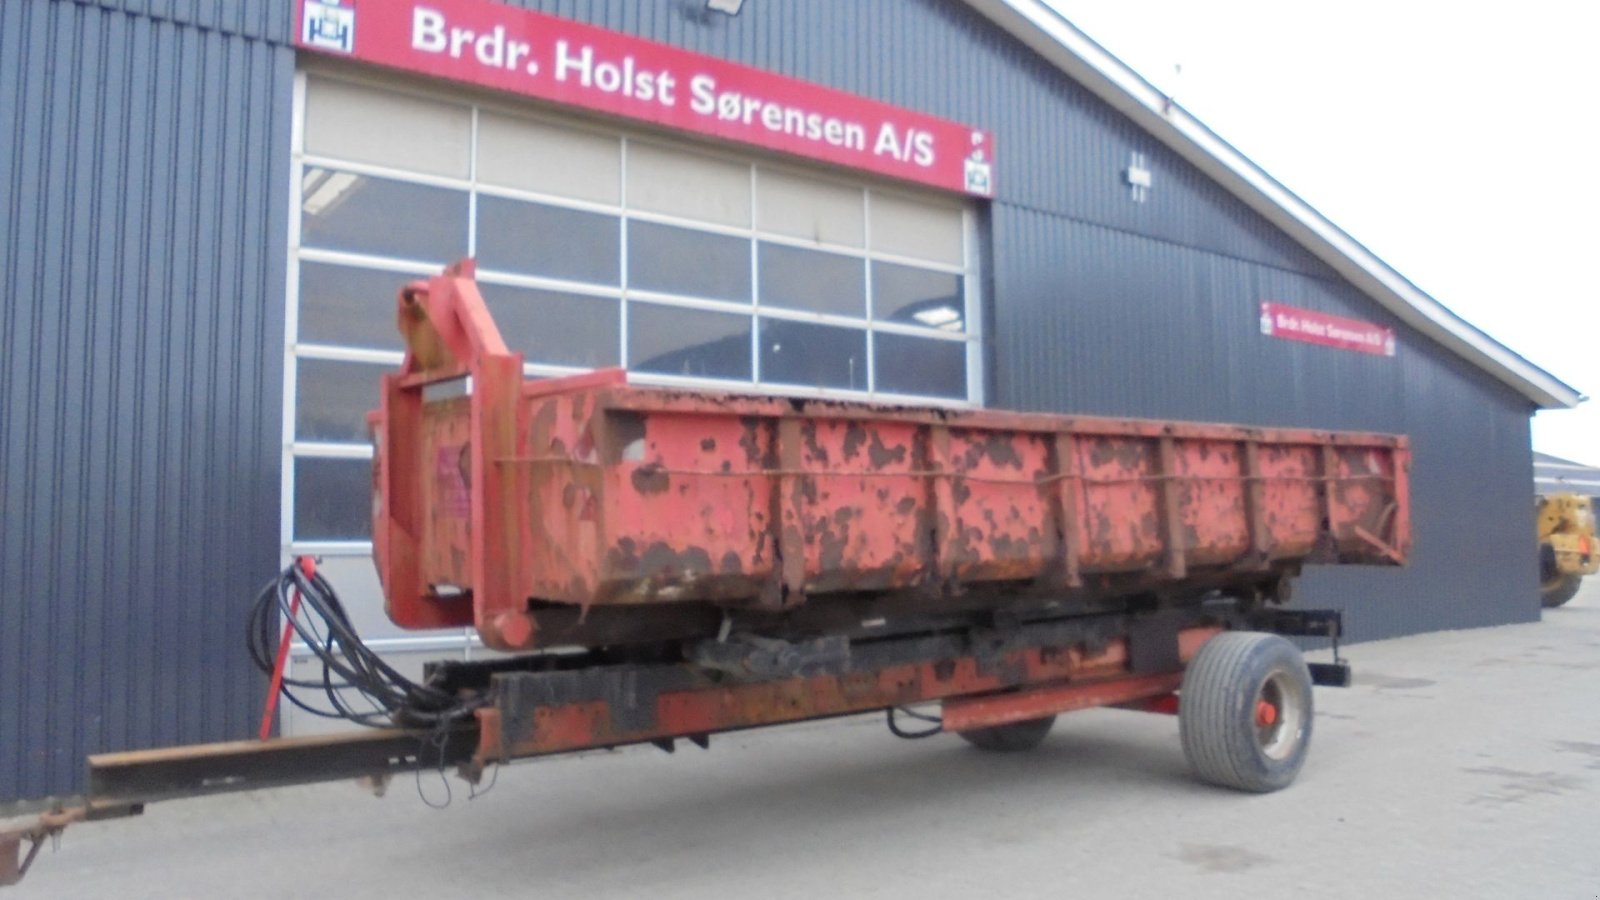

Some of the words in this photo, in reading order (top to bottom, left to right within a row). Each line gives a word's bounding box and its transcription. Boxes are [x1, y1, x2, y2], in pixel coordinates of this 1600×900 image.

[411, 6, 539, 76] Brdr.
[555, 39, 675, 106] Holst
[690, 74, 865, 151] Sørensen
[874, 121, 935, 167] A/S
